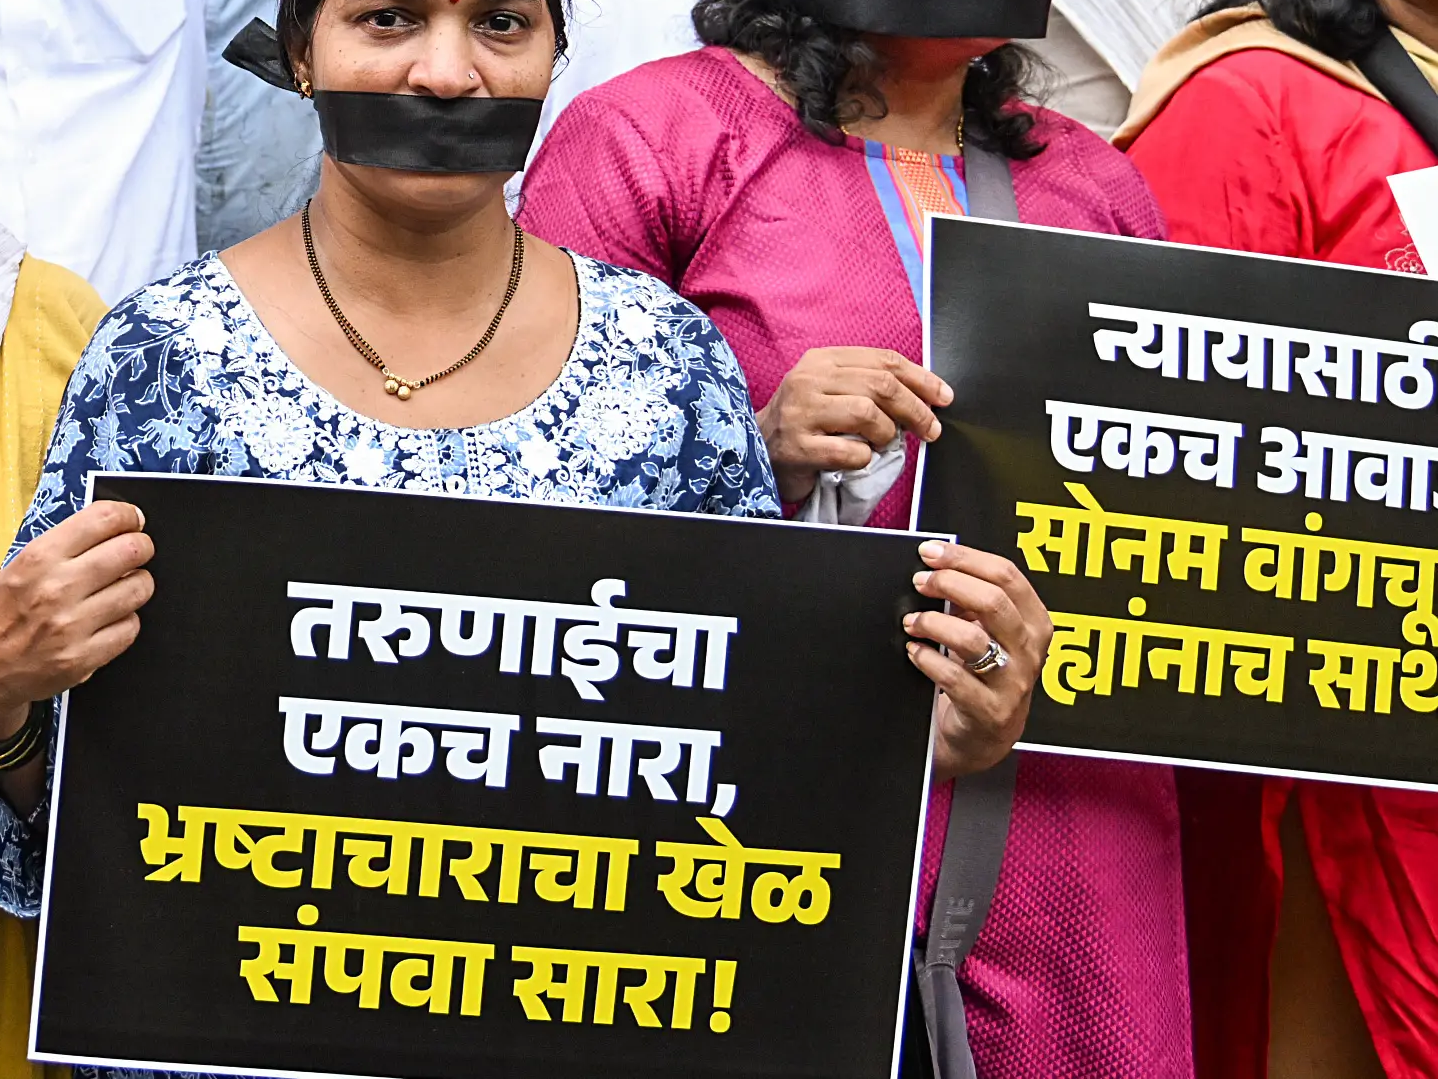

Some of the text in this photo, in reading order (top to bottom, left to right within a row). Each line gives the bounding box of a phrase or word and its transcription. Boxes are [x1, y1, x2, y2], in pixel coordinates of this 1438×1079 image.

[1045, 400, 1438, 511] एकच आवा
[1015, 481, 1229, 591] सोनम
[285, 578, 738, 702] तरुणाईचा
[277, 696, 738, 817] एकच नारा,
[137, 802, 842, 926] भ्रष्टाचाराचा खेळ
[237, 905, 738, 1035] संपवा सारा!
